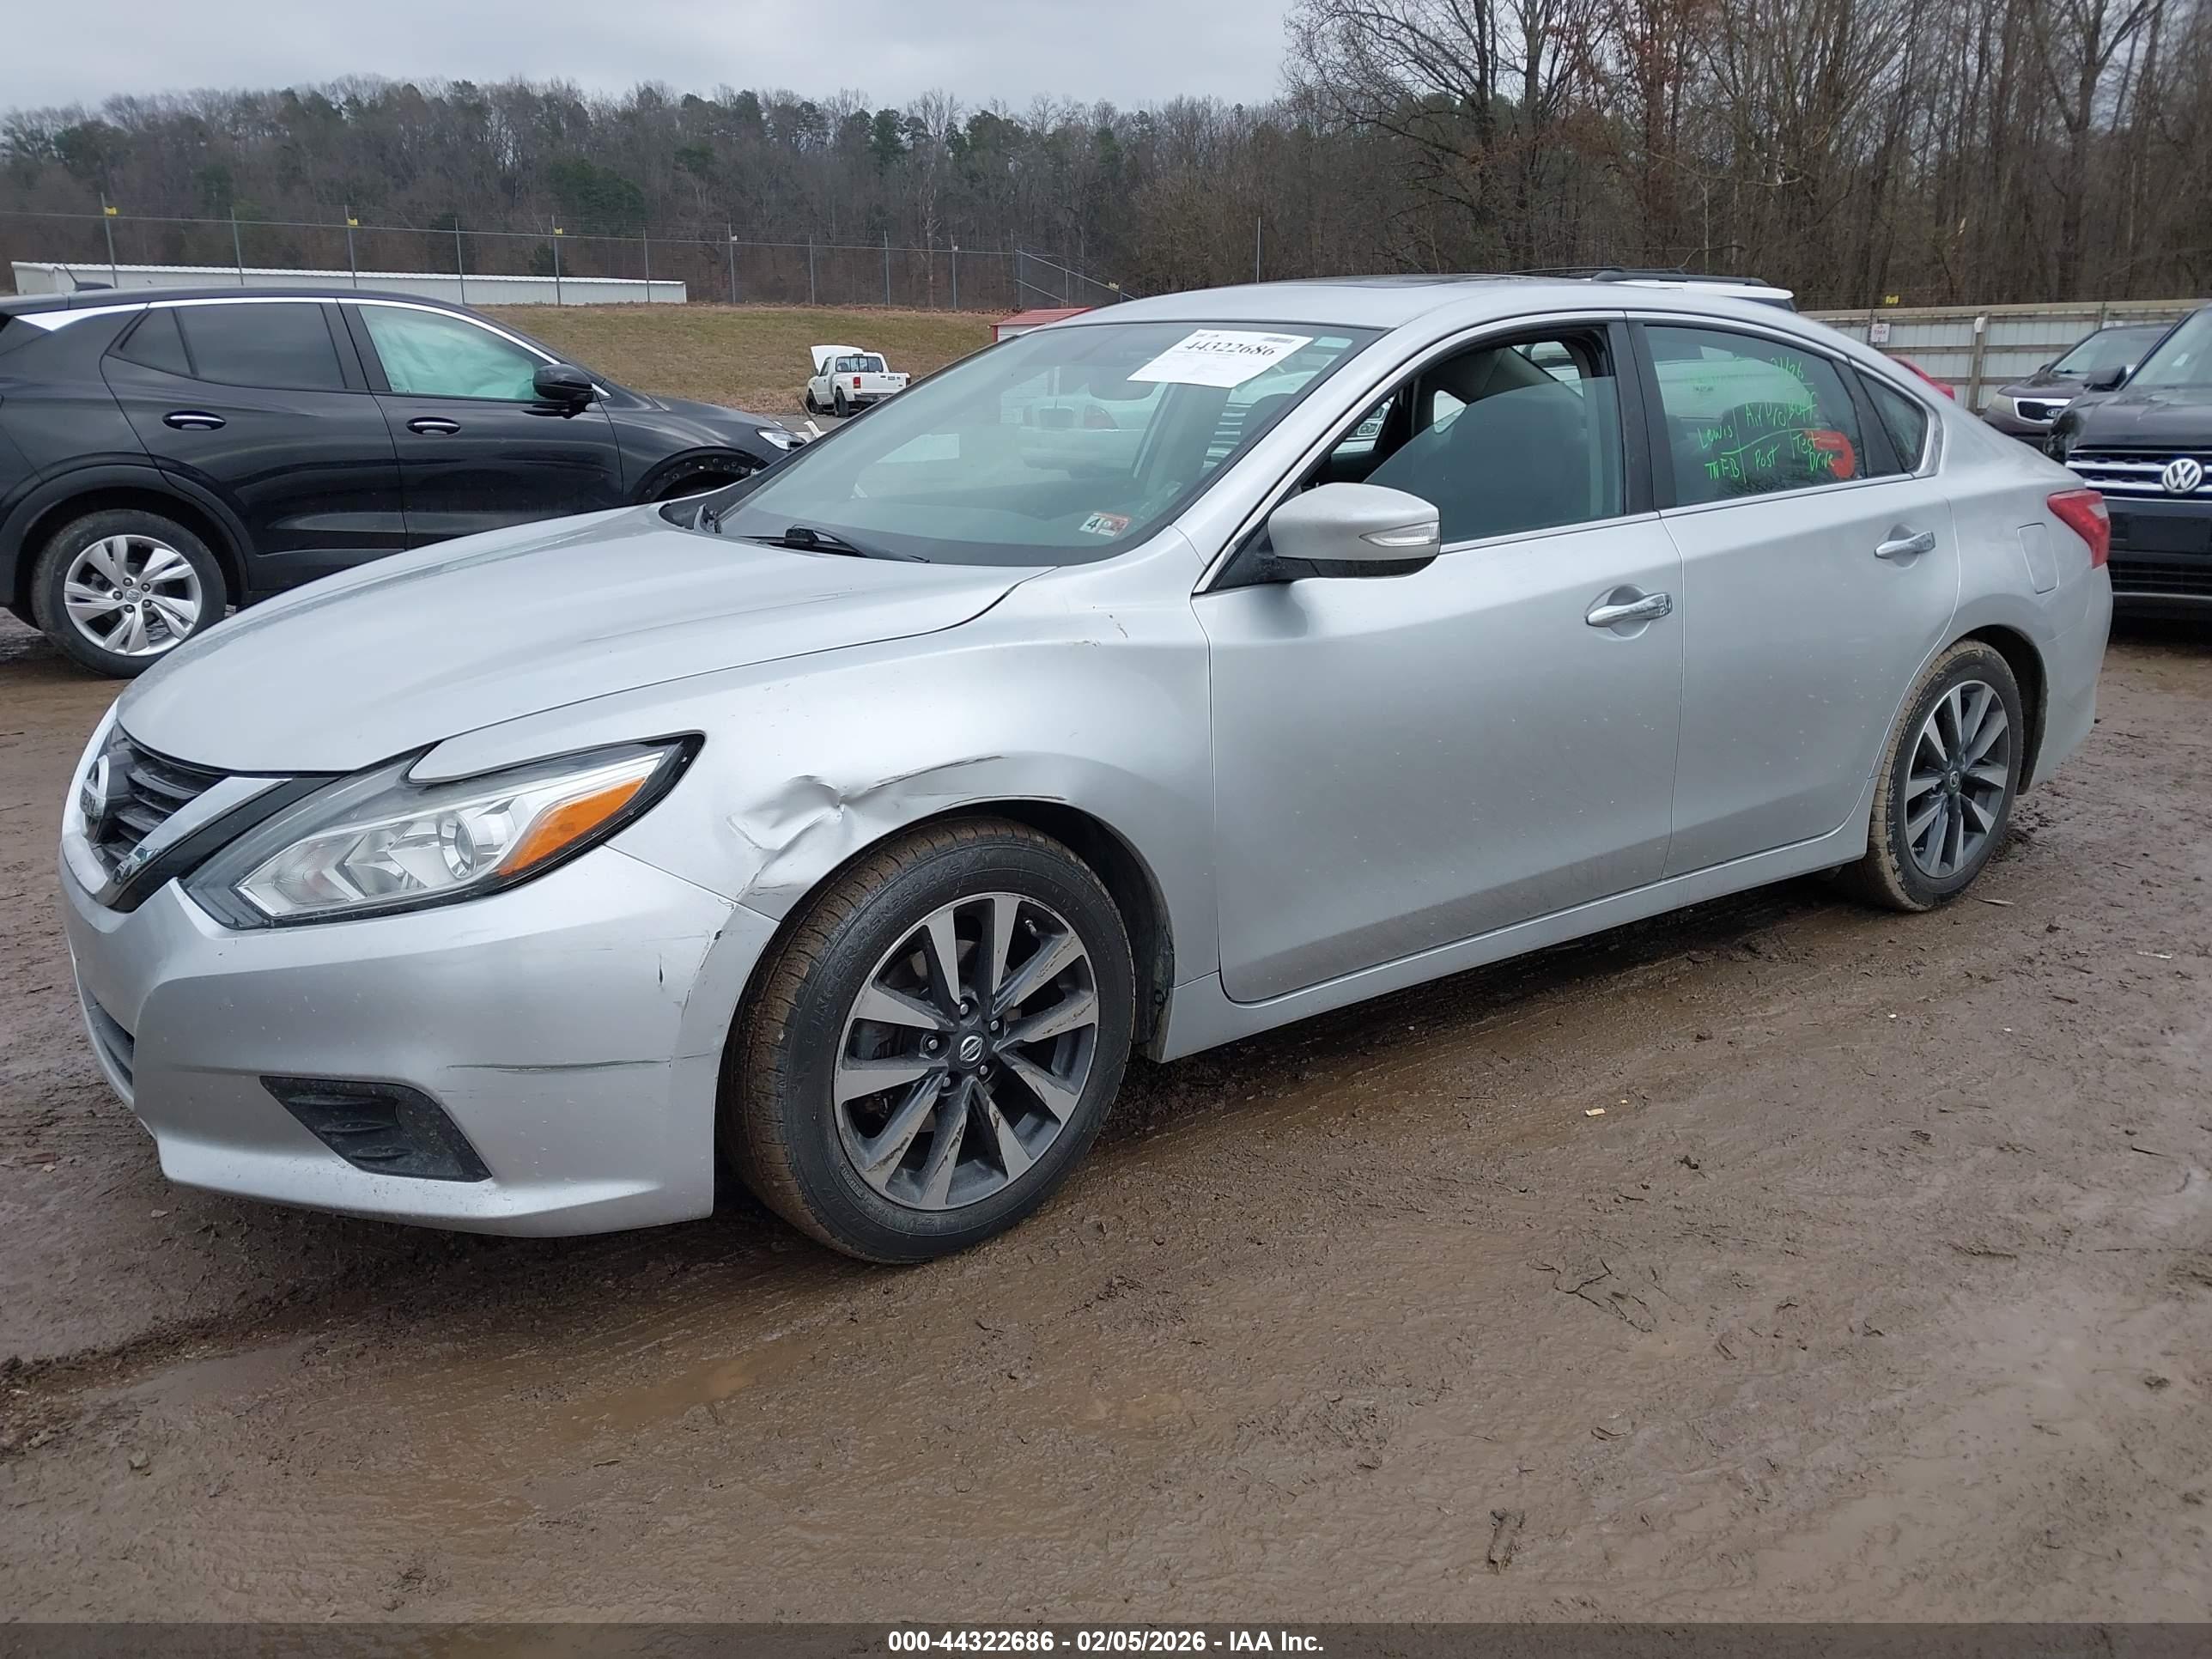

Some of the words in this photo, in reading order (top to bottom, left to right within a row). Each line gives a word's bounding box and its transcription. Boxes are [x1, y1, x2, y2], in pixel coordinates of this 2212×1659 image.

[1184, 341, 1278, 356] 44322686
[1792, 430, 1820, 453] Test
[1754, 444, 1780, 471] Post
[1808, 451, 1835, 472] Drive
[1086, 518, 1101, 529] 4
